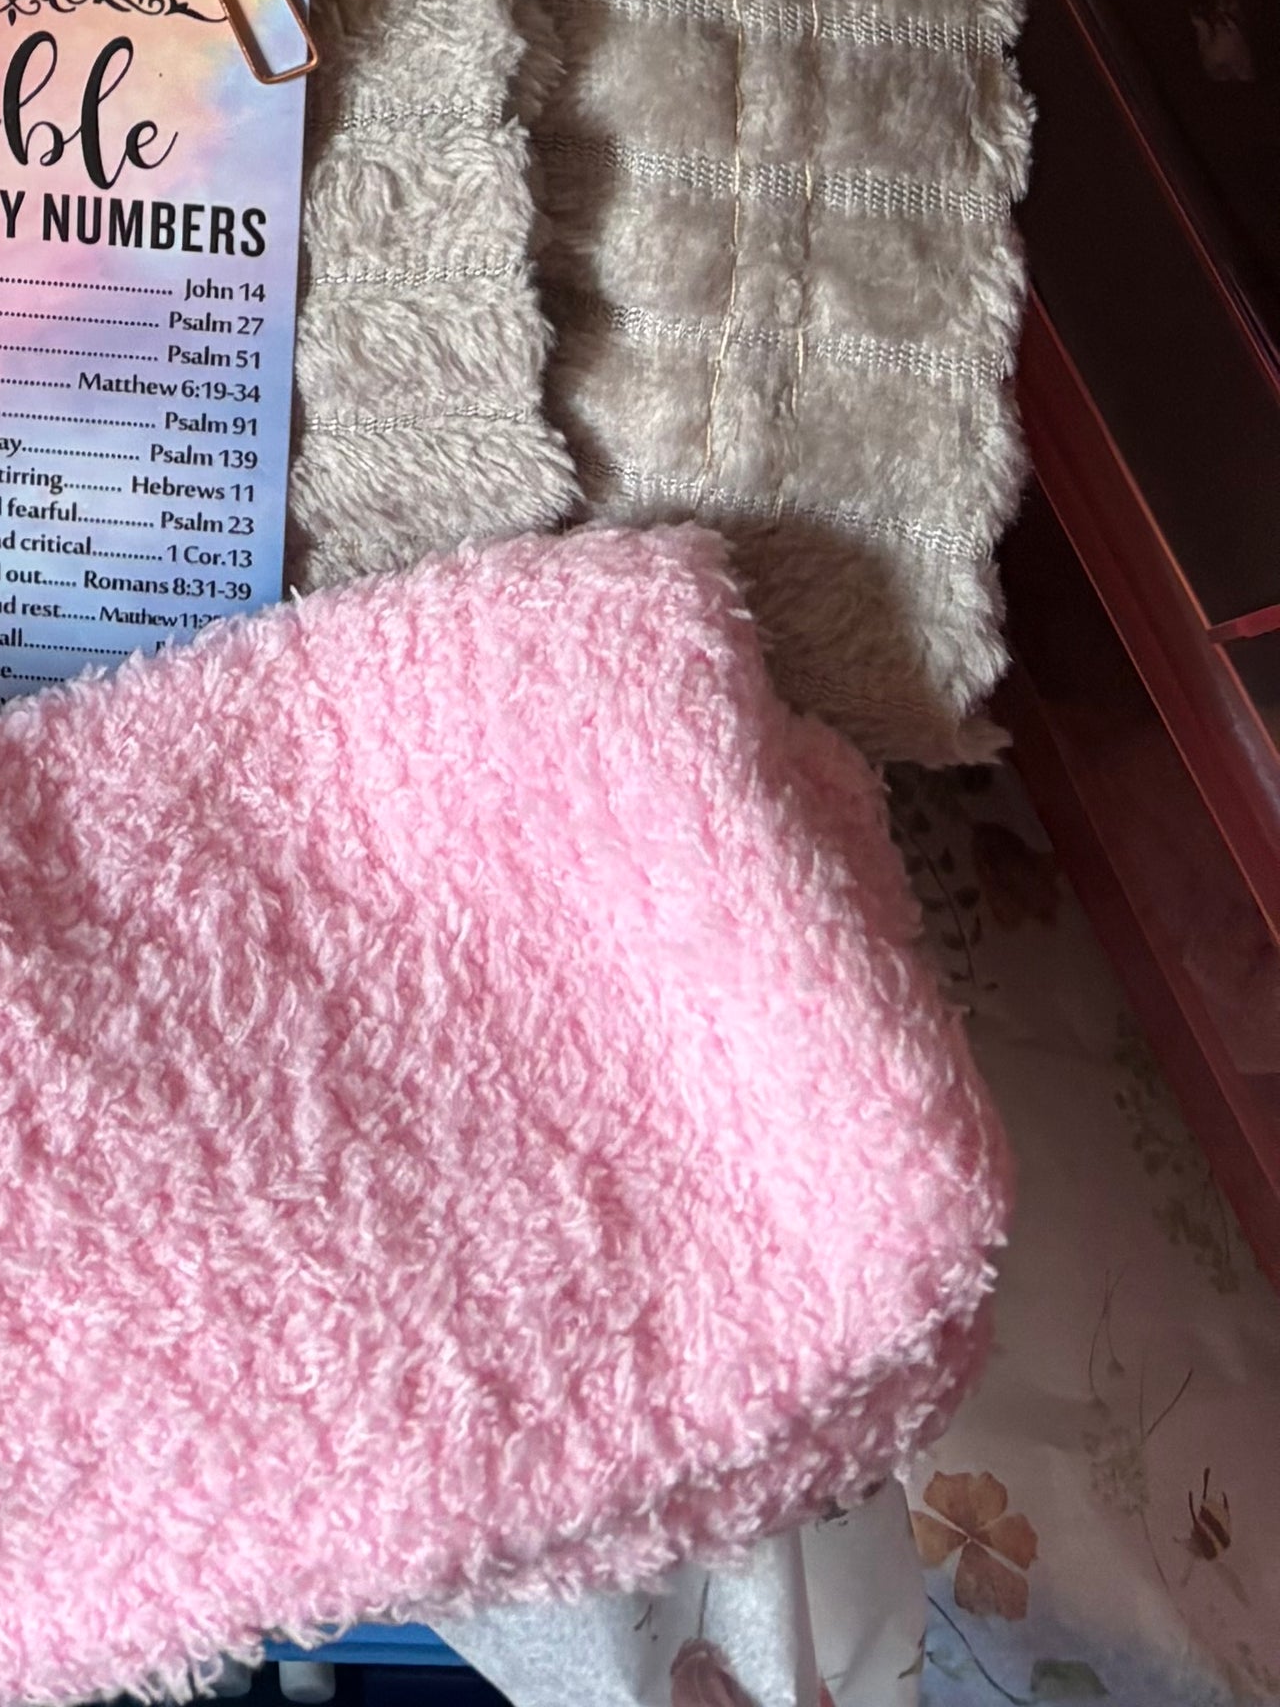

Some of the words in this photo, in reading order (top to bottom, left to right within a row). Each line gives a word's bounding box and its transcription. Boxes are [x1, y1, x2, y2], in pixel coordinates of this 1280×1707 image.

[42, 193, 267, 258] NUMBERS
[184, 279, 234, 302] John
[240, 283, 266, 302] 14
[169, 311, 232, 335] Psalm
[237, 316, 264, 336] 27
[168, 345, 231, 368] Psalm
[236, 350, 260, 369] 51
[78, 372, 175, 397] Matthew
[181, 379, 260, 403] 6:19-34
[165, 412, 227, 433] Psalm
[232, 416, 258, 436] 91
[150, 444, 213, 465] Psalm
[219, 449, 258, 469] 139
[132, 475, 225, 500] Hebrews
[231, 483, 255, 502] 11
[7, 497, 78, 522] fearful
[160, 511, 222, 533] Psalm
[228, 515, 254, 535] 23
